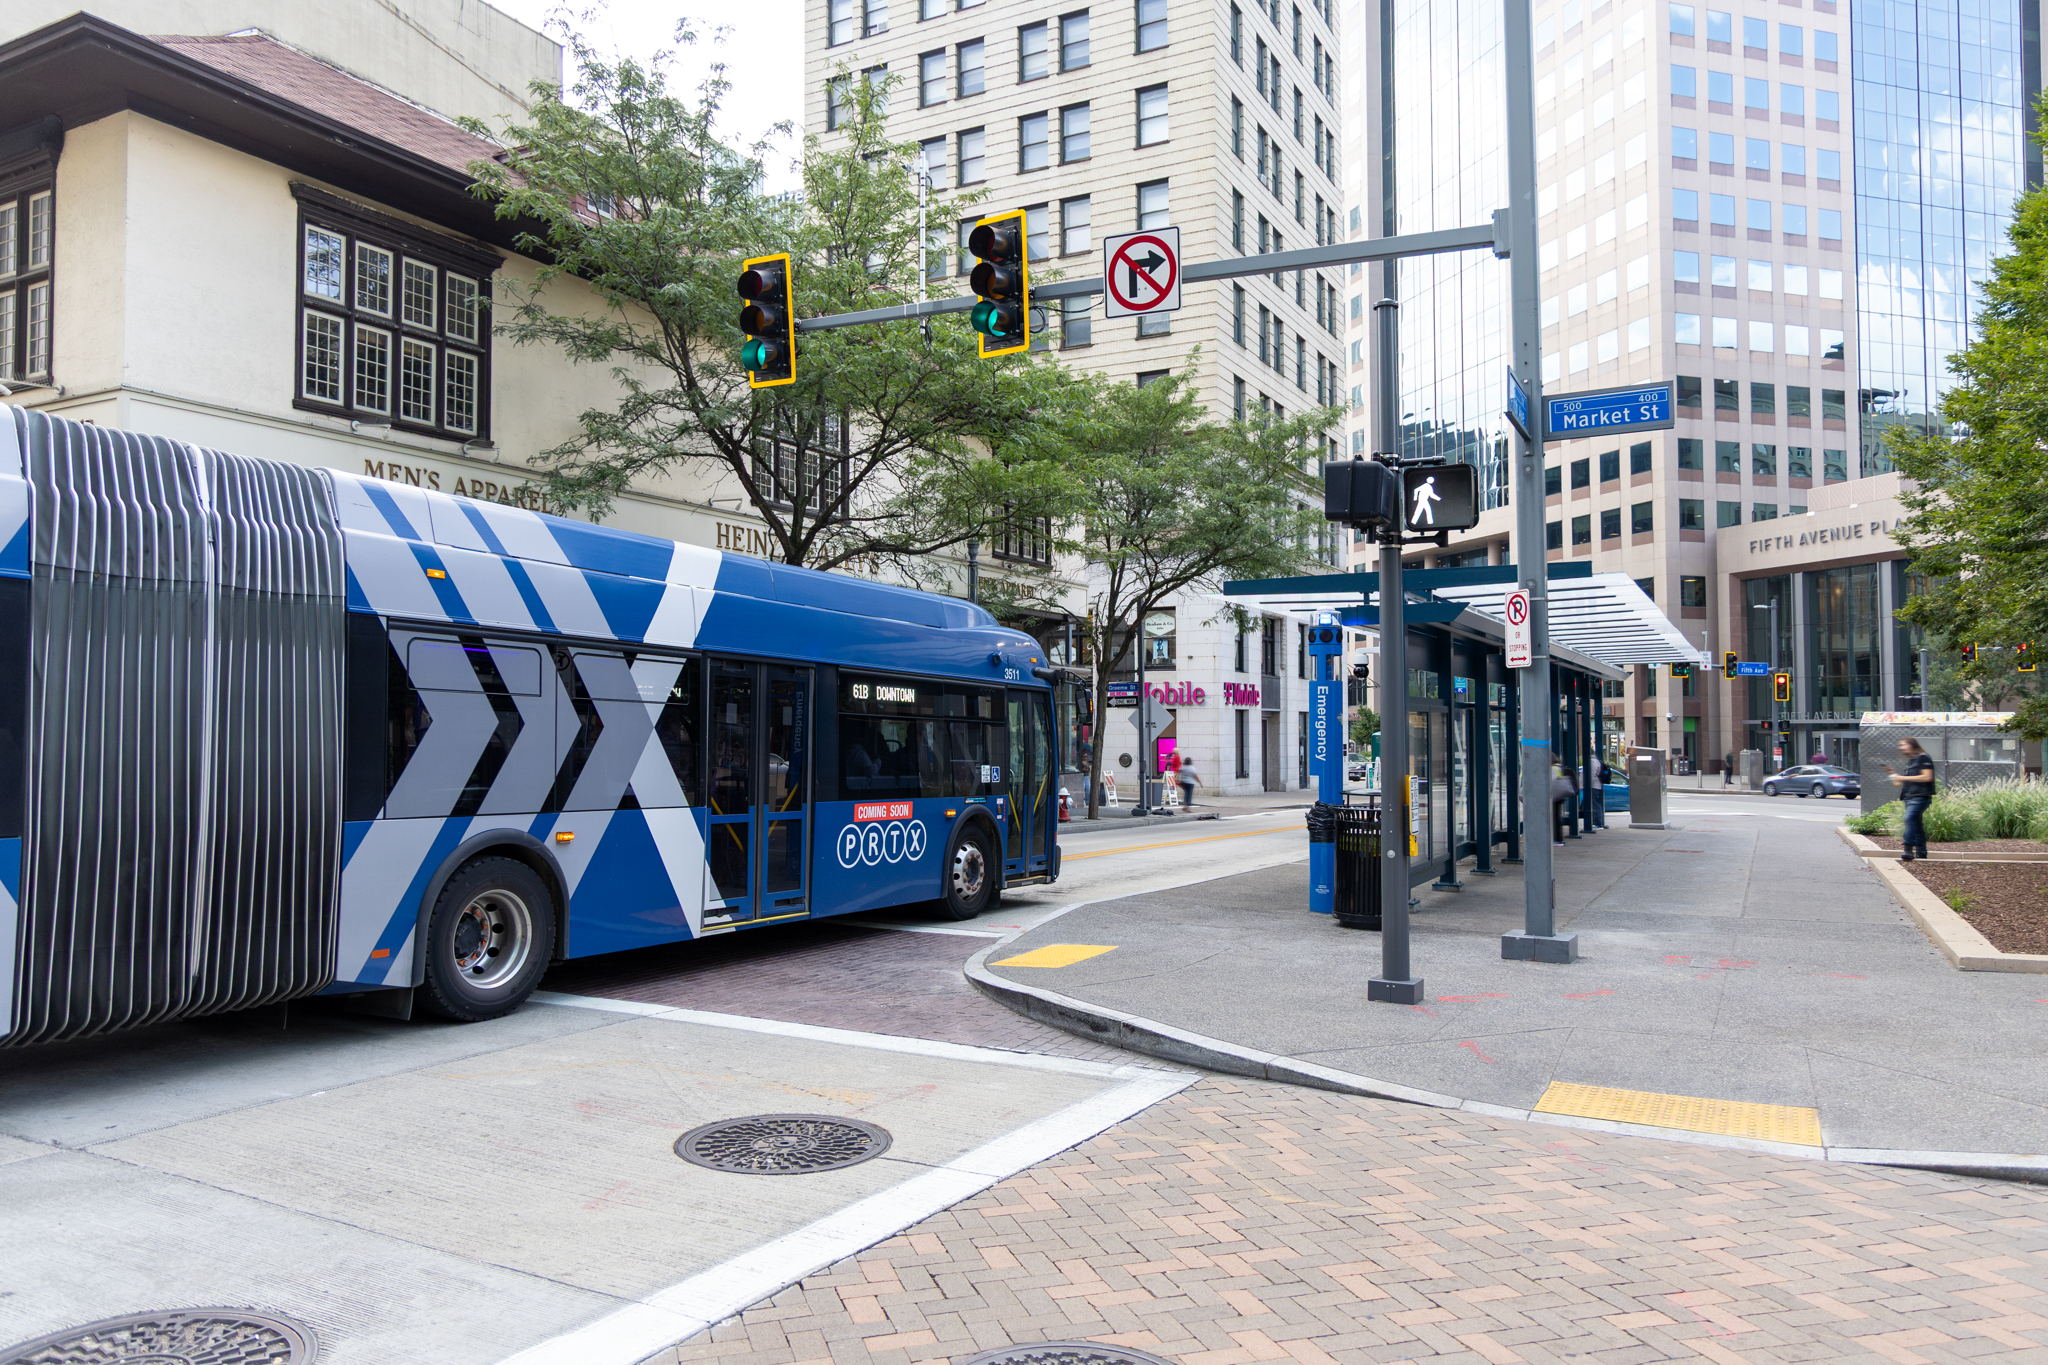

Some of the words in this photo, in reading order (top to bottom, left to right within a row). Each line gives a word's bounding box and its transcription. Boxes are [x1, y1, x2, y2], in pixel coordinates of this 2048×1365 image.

[1563, 402, 1582, 412] 500
[1638, 393, 1658, 403] 400
[1563, 409, 1630, 429] Market
[1640, 404, 1659, 421] St
[364, 459, 440, 492] MEN'S
[1750, 535, 1793, 554] FIFTH
[1799, 523, 1863, 546] AVENUE
[1509, 643, 1527, 653] STOPPING
[1004, 668, 1019, 680] 3511
[852, 684, 869, 699] 61B
[876, 686, 915, 702] DOWNTOWN
[1315, 686, 1329, 762] Emergency
[1813, 711, 1854, 720] AVENUE
[858, 806, 887, 819] COMING
[890, 804, 909, 817] SOON
